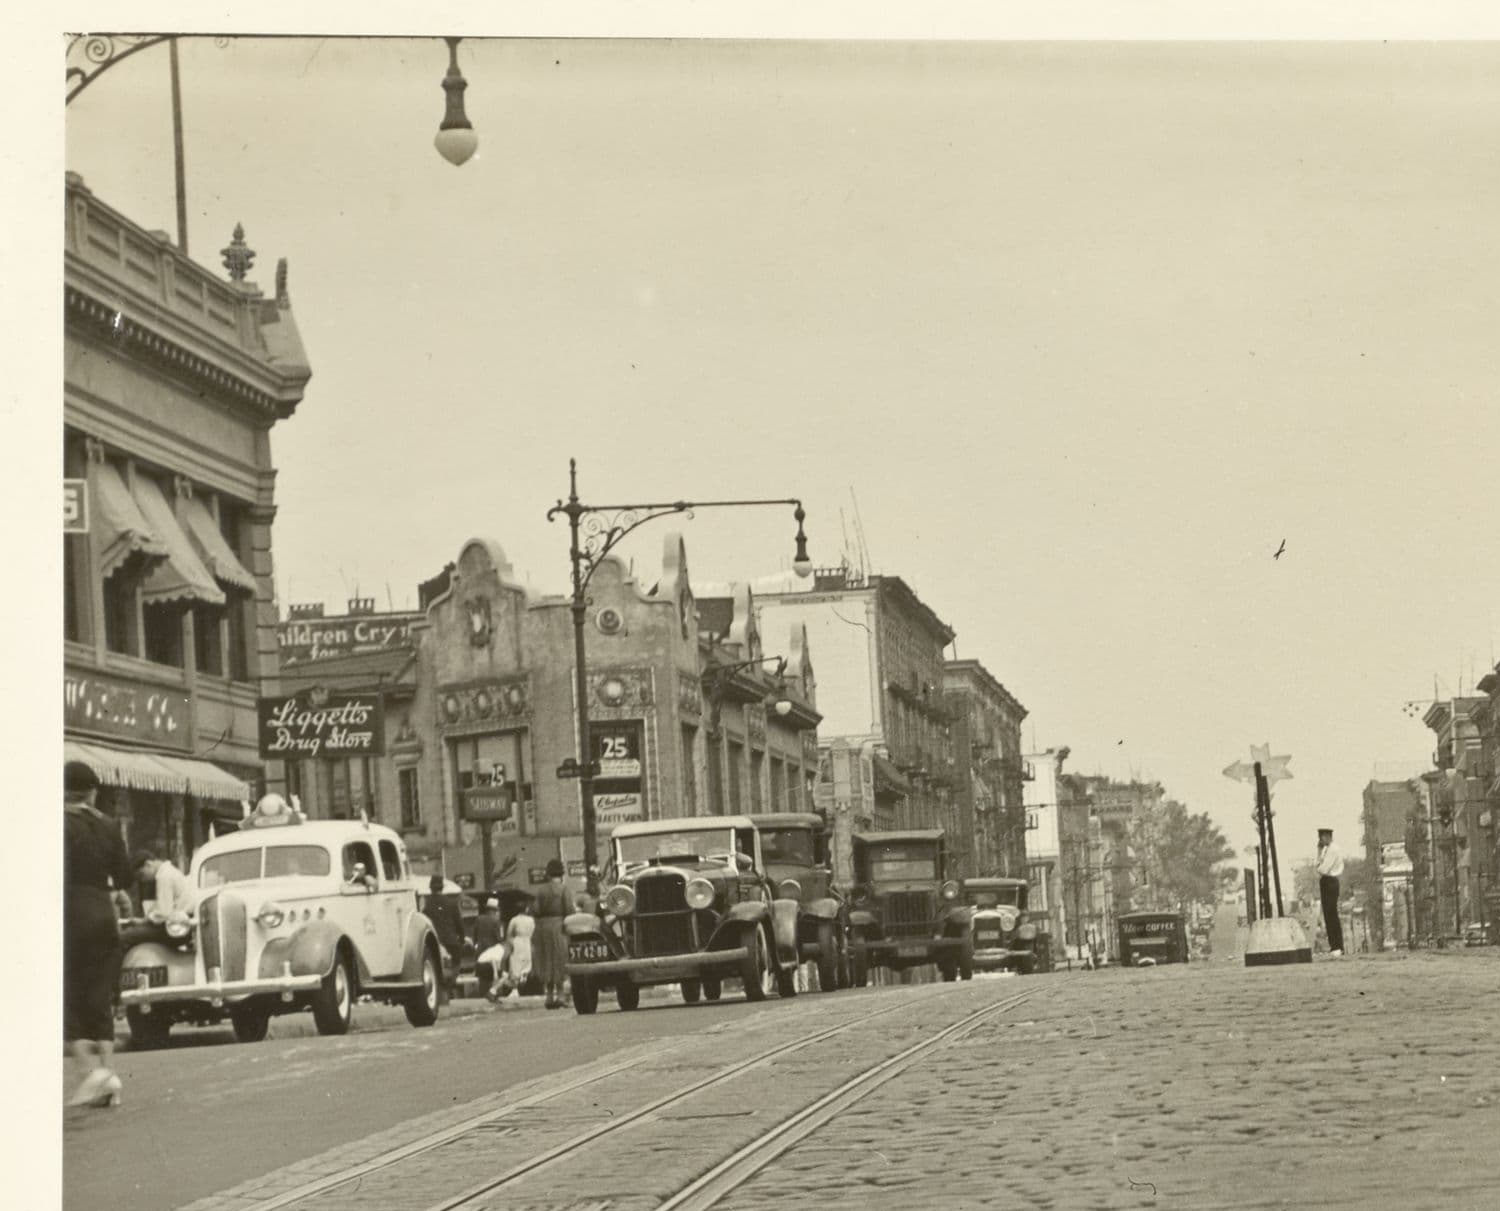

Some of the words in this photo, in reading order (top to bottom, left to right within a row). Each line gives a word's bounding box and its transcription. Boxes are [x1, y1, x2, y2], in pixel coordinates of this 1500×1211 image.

[354, 622, 397, 646] Cry
[268, 727, 320, 756] Drug
[325, 726, 373, 748] Store
[602, 737, 628, 759] 25
[1145, 922, 1175, 932] COFFEE
